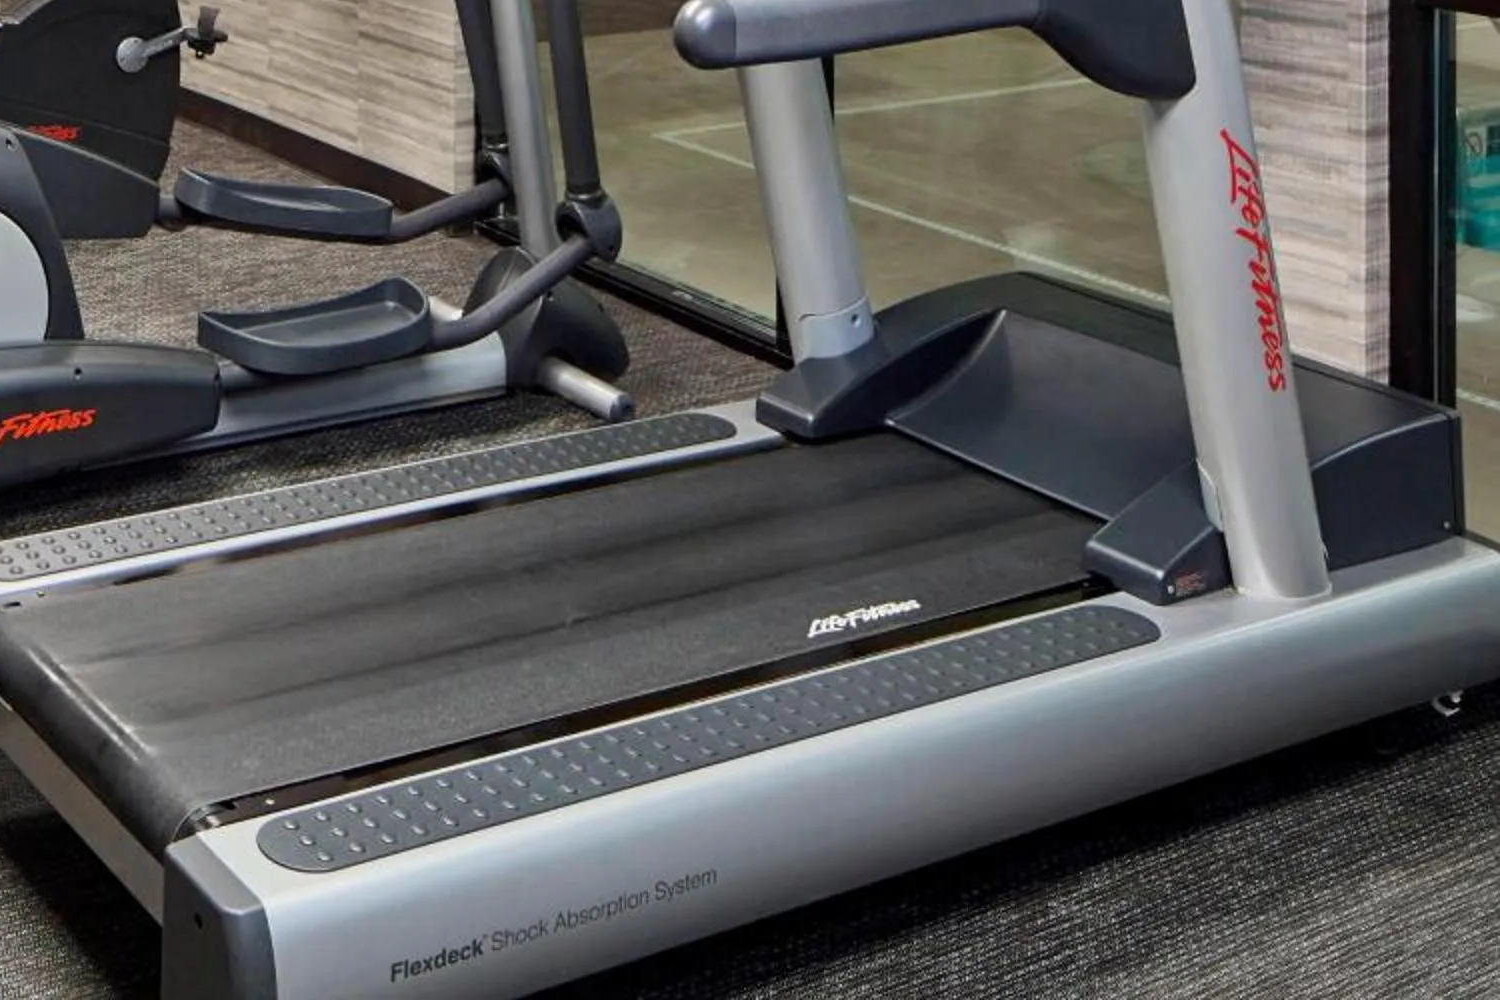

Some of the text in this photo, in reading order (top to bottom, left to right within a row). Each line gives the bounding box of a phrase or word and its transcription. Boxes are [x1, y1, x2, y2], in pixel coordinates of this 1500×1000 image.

[491, 919, 549, 951] Shock
[553, 889, 649, 931] Absorption
[654, 868, 718, 901] System
